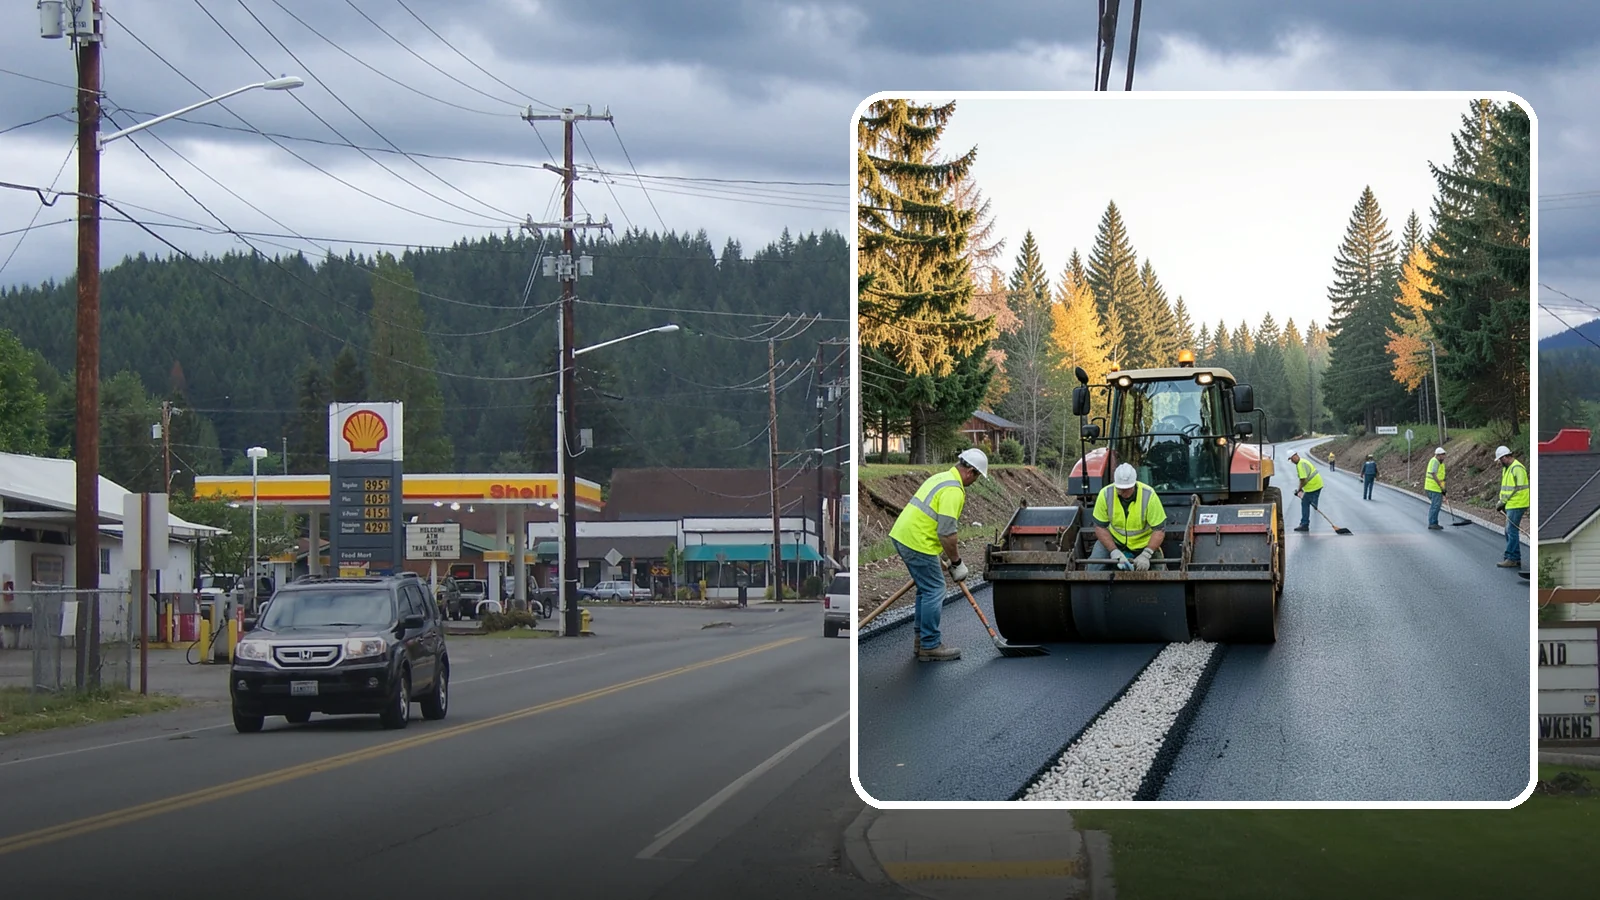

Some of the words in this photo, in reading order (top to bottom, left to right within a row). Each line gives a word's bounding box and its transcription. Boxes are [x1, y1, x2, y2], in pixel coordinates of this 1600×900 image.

[366, 480, 383, 490] 395
[490, 484, 547, 499] Shell
[365, 494, 383, 504] 405
[366, 508, 383, 518] 415
[366, 522, 383, 532] 429
